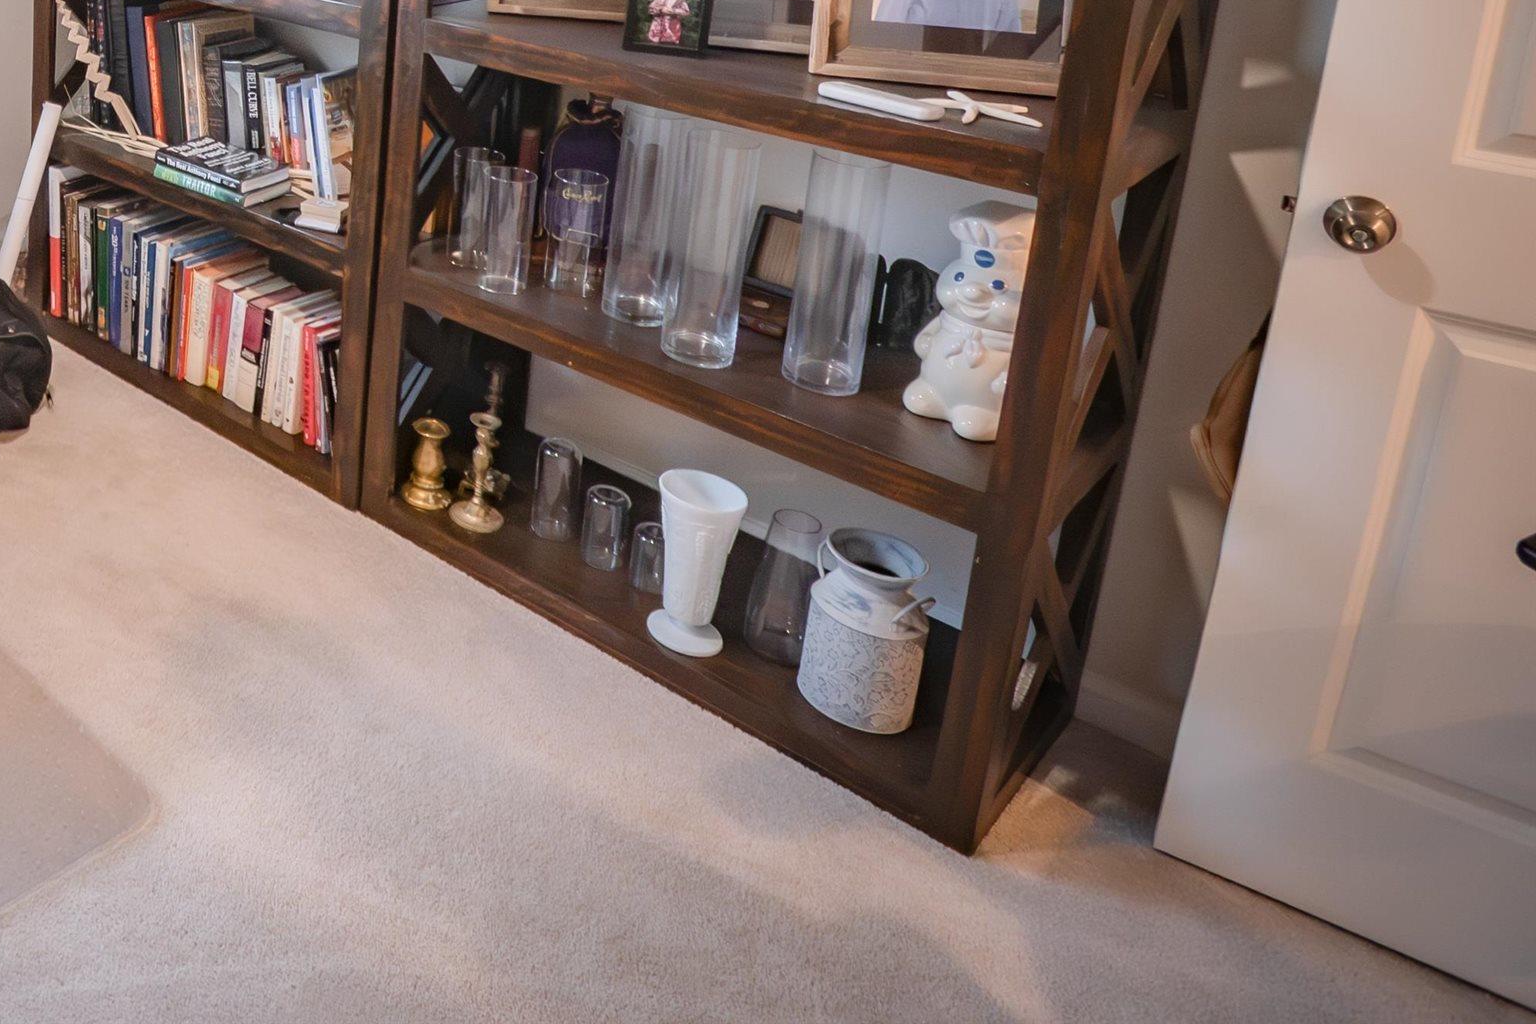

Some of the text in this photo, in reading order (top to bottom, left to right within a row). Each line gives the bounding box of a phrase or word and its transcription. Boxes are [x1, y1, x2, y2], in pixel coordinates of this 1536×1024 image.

[246, 72, 257, 91] BELL
[248, 92, 258, 119] CURVE
[182, 175, 217, 198] TRAITOR
